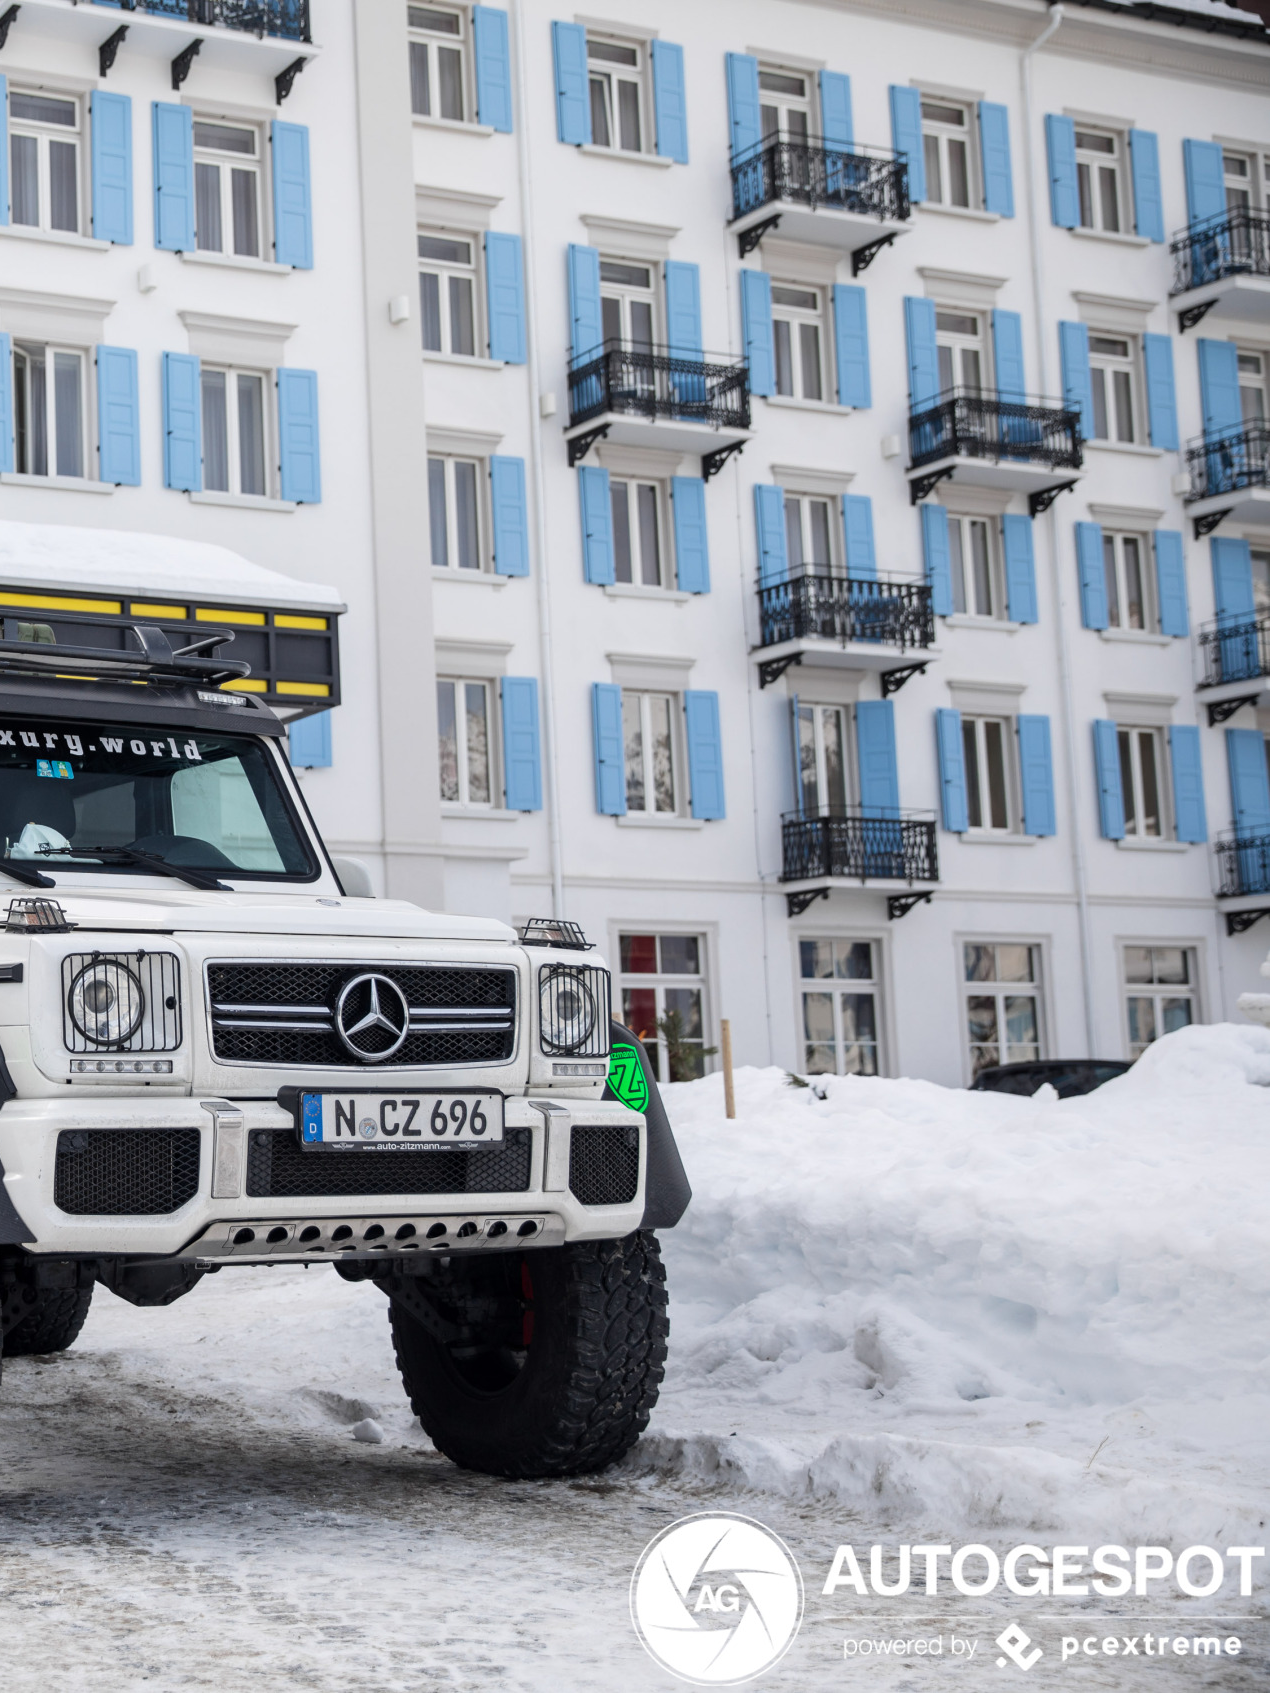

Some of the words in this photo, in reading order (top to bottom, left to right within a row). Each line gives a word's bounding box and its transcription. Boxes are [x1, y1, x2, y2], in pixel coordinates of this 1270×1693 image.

[334, 1099, 356, 1137] N
[379, 1099, 422, 1137] CZ
[430, 1099, 487, 1137] 696
[309, 1123, 317, 1134] D
[362, 1142, 451, 1150] www.auto-zitzmann.com
